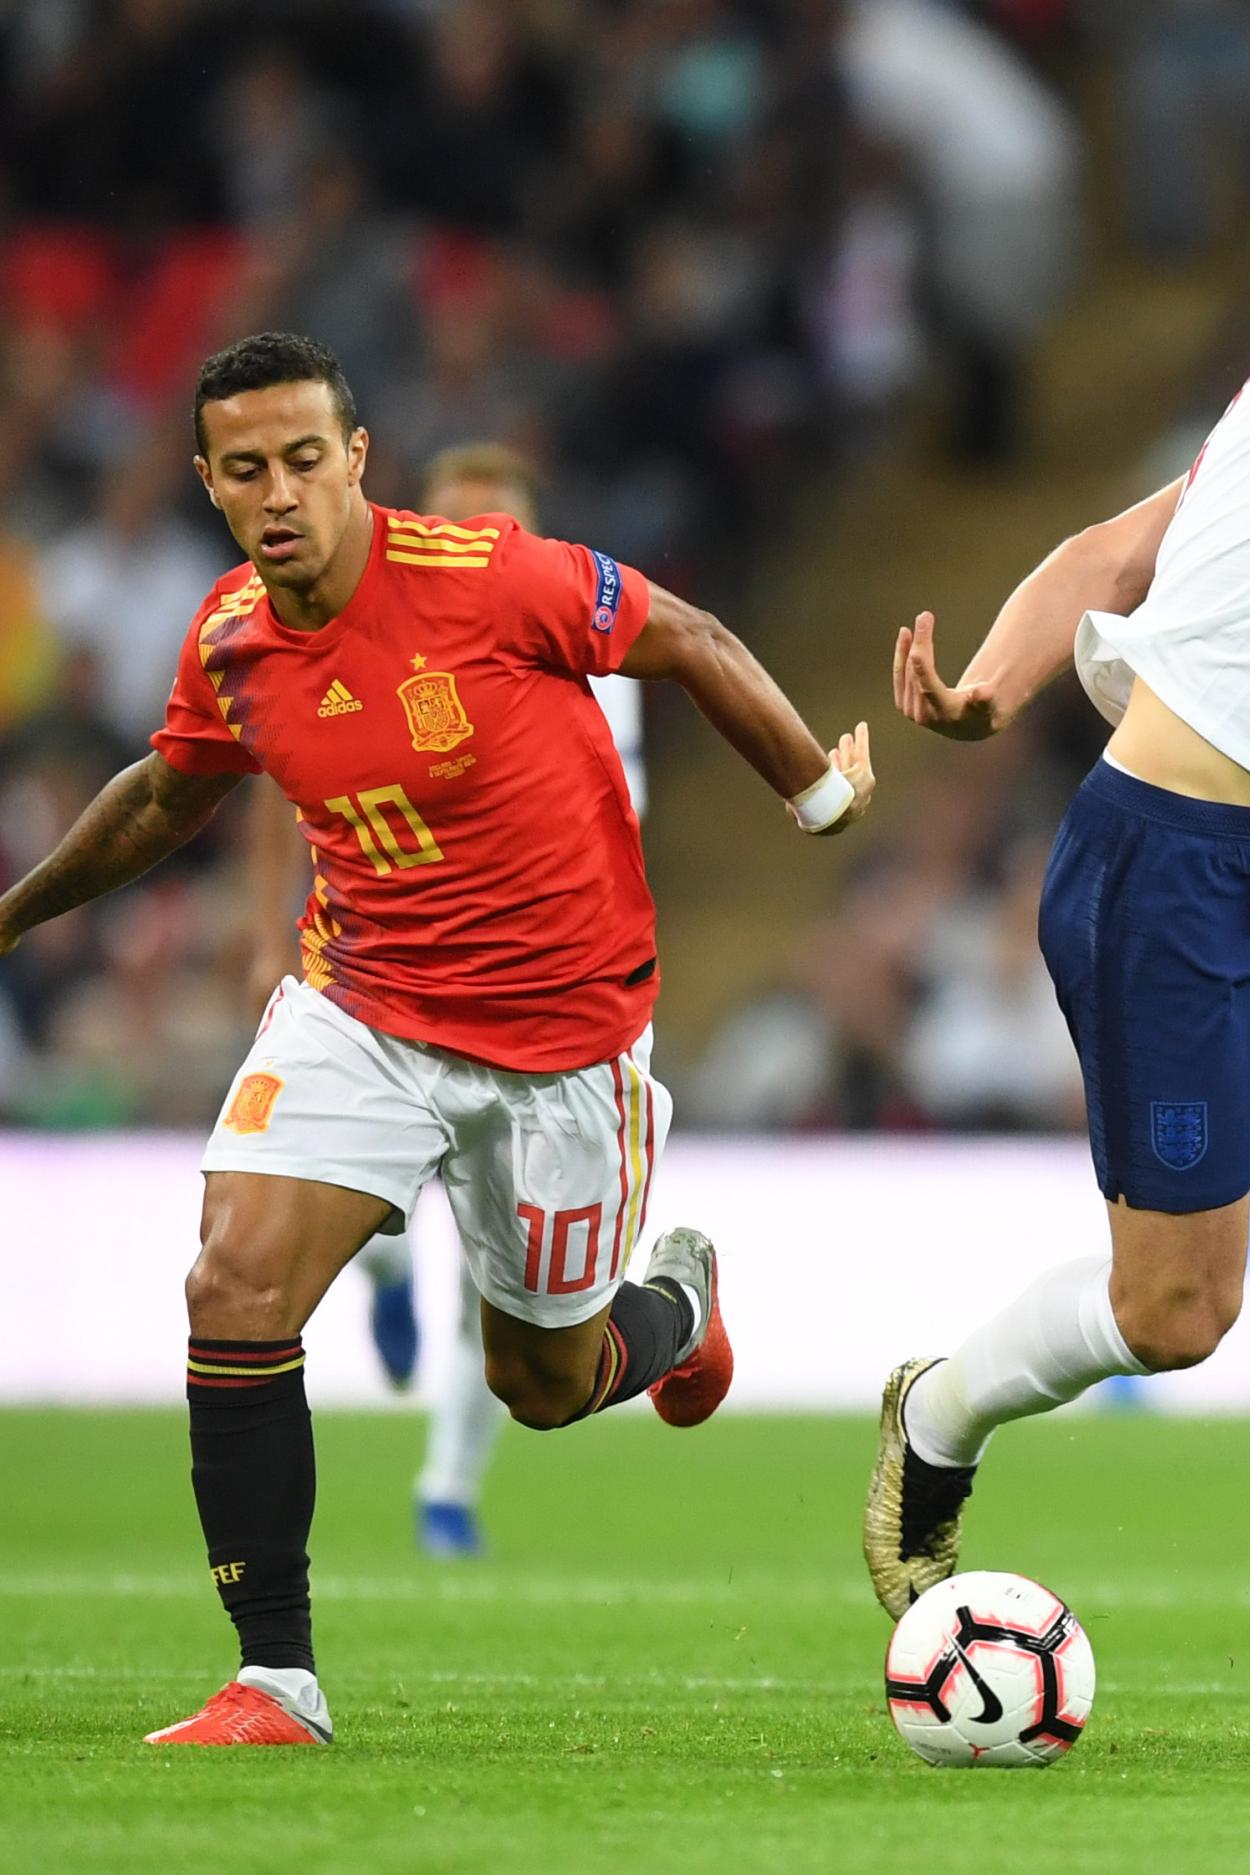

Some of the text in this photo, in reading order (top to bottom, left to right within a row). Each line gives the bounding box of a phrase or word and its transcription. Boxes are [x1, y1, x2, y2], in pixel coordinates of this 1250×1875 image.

[317, 699, 364, 718] adidas
[323, 784, 445, 876] 10
[516, 1201, 603, 1295] 10
